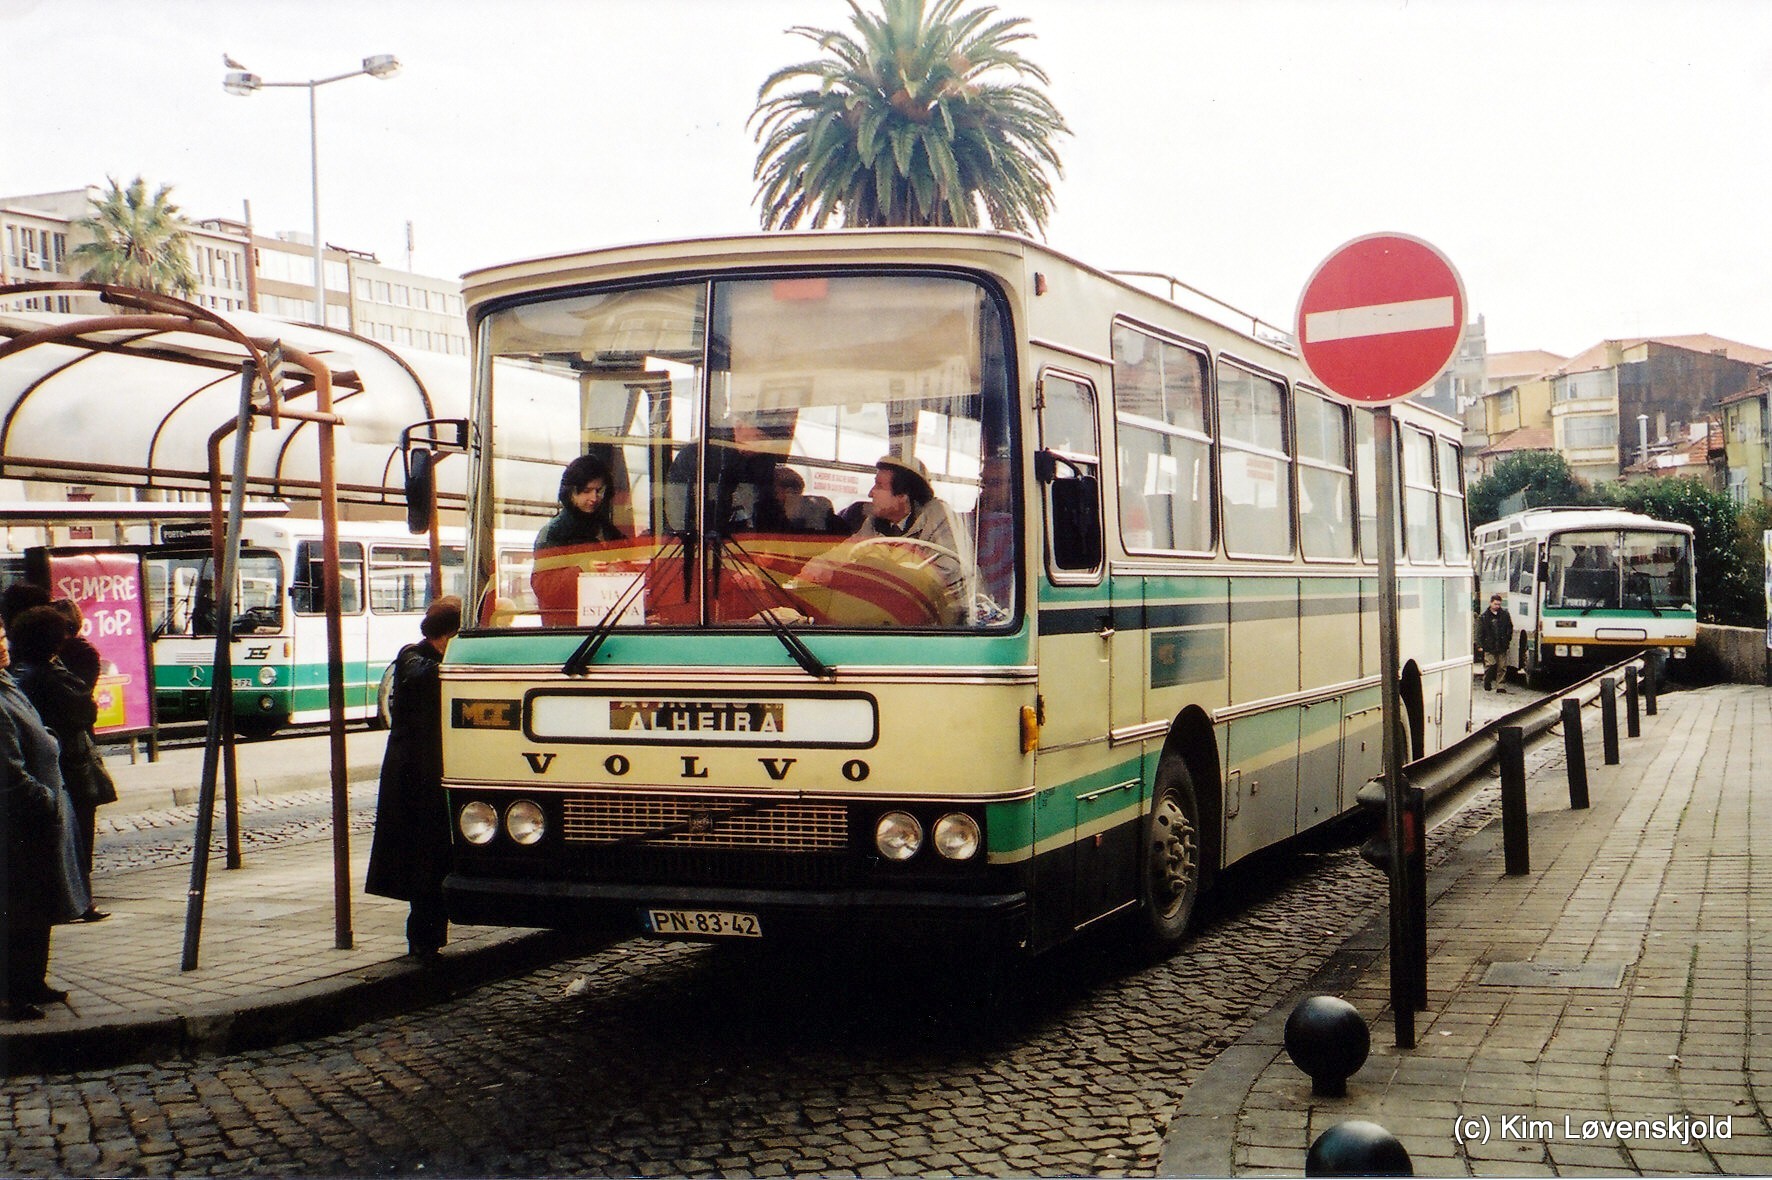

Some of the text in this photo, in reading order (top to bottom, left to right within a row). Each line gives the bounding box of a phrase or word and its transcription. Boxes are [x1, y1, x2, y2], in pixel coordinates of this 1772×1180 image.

[57, 574, 137, 604] SEMPRE
[628, 711, 778, 732] ALHEIRA
[521, 752, 871, 783] VOLVO
